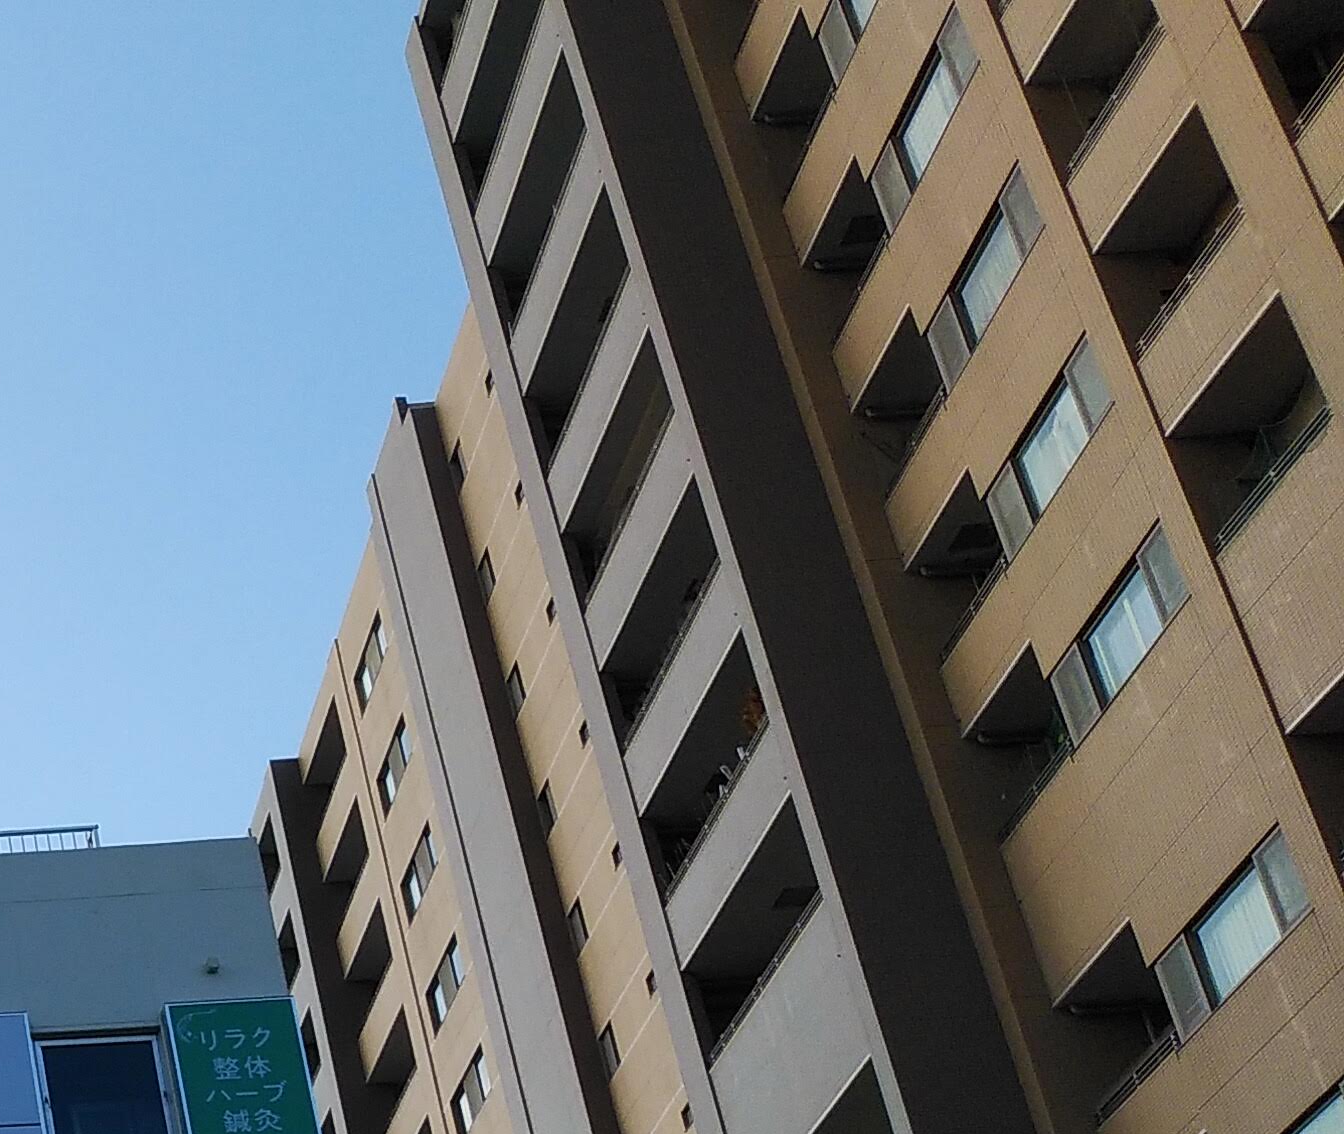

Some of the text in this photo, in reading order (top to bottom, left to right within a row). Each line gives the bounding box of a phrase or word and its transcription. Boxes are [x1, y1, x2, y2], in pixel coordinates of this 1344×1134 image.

[199, 1026, 272, 1051] リラク
[212, 1055, 272, 1080] 整体
[206, 1080, 288, 1103] ハーブ
[223, 1108, 283, 1133] 鍼灸
